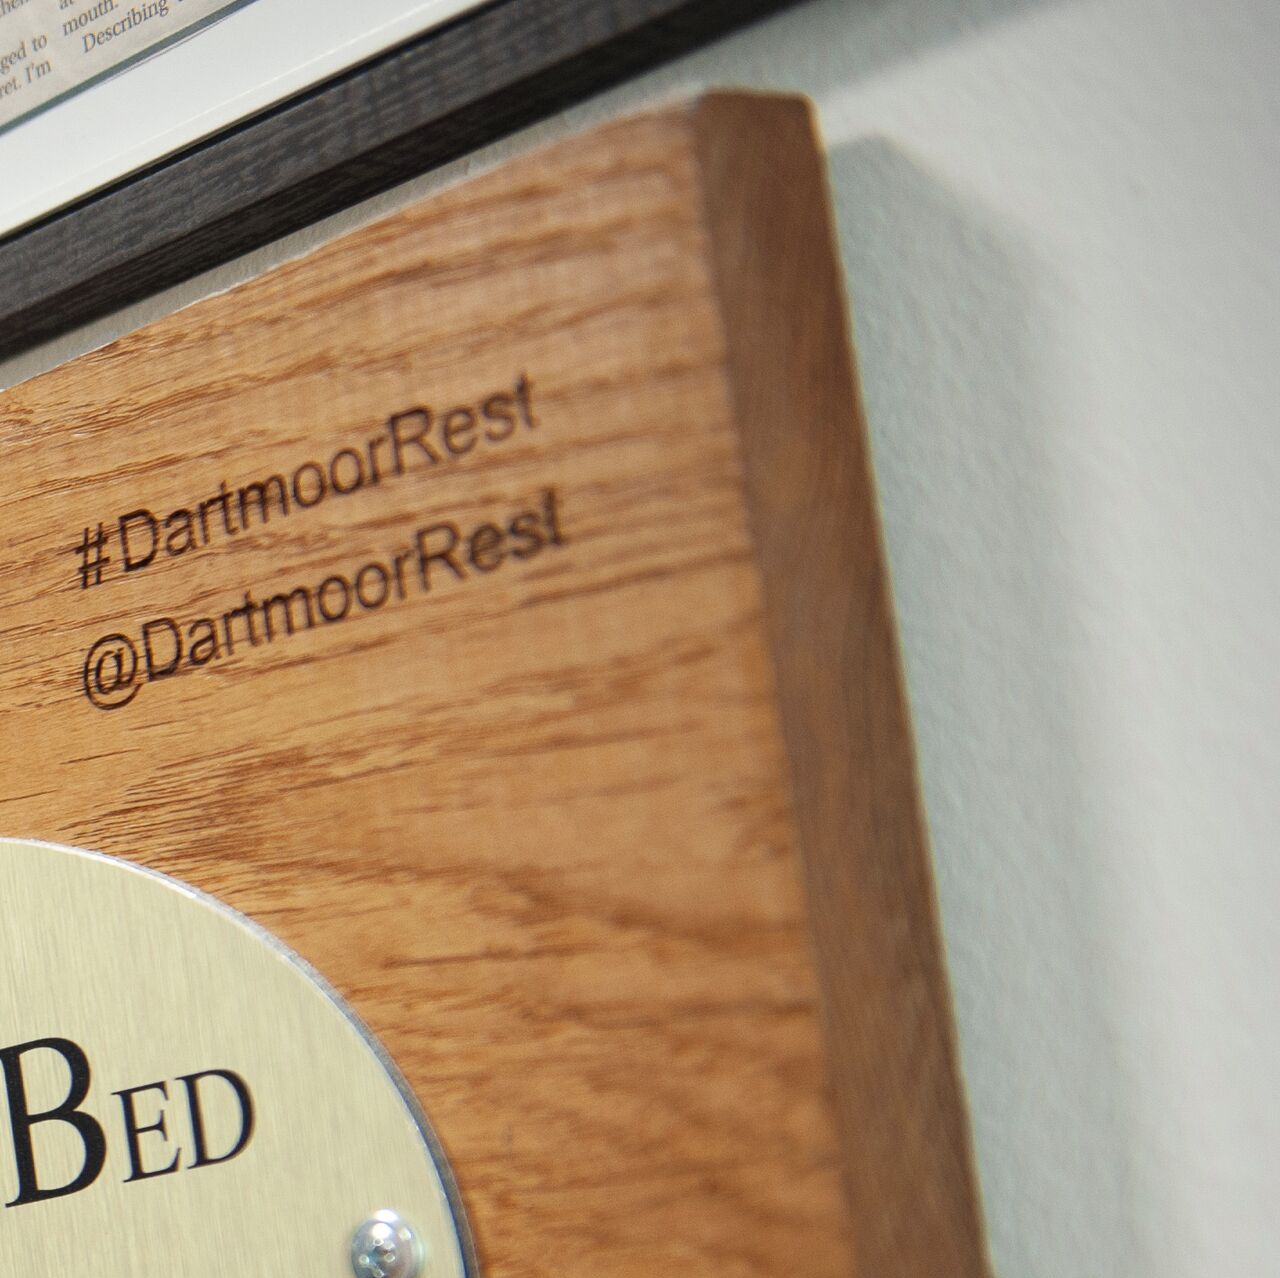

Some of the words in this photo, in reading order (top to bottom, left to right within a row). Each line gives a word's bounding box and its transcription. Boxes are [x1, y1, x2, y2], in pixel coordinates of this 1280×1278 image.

[62, 0, 120, 36] mouth.
[82, 0, 170, 53] Describing
[31, 34, 49, 55] to
[24, 58, 53, 85] I'm
[74, 373, 540, 590] #DartmoorRest
[83, 487, 569, 710] @DartmoorRest
